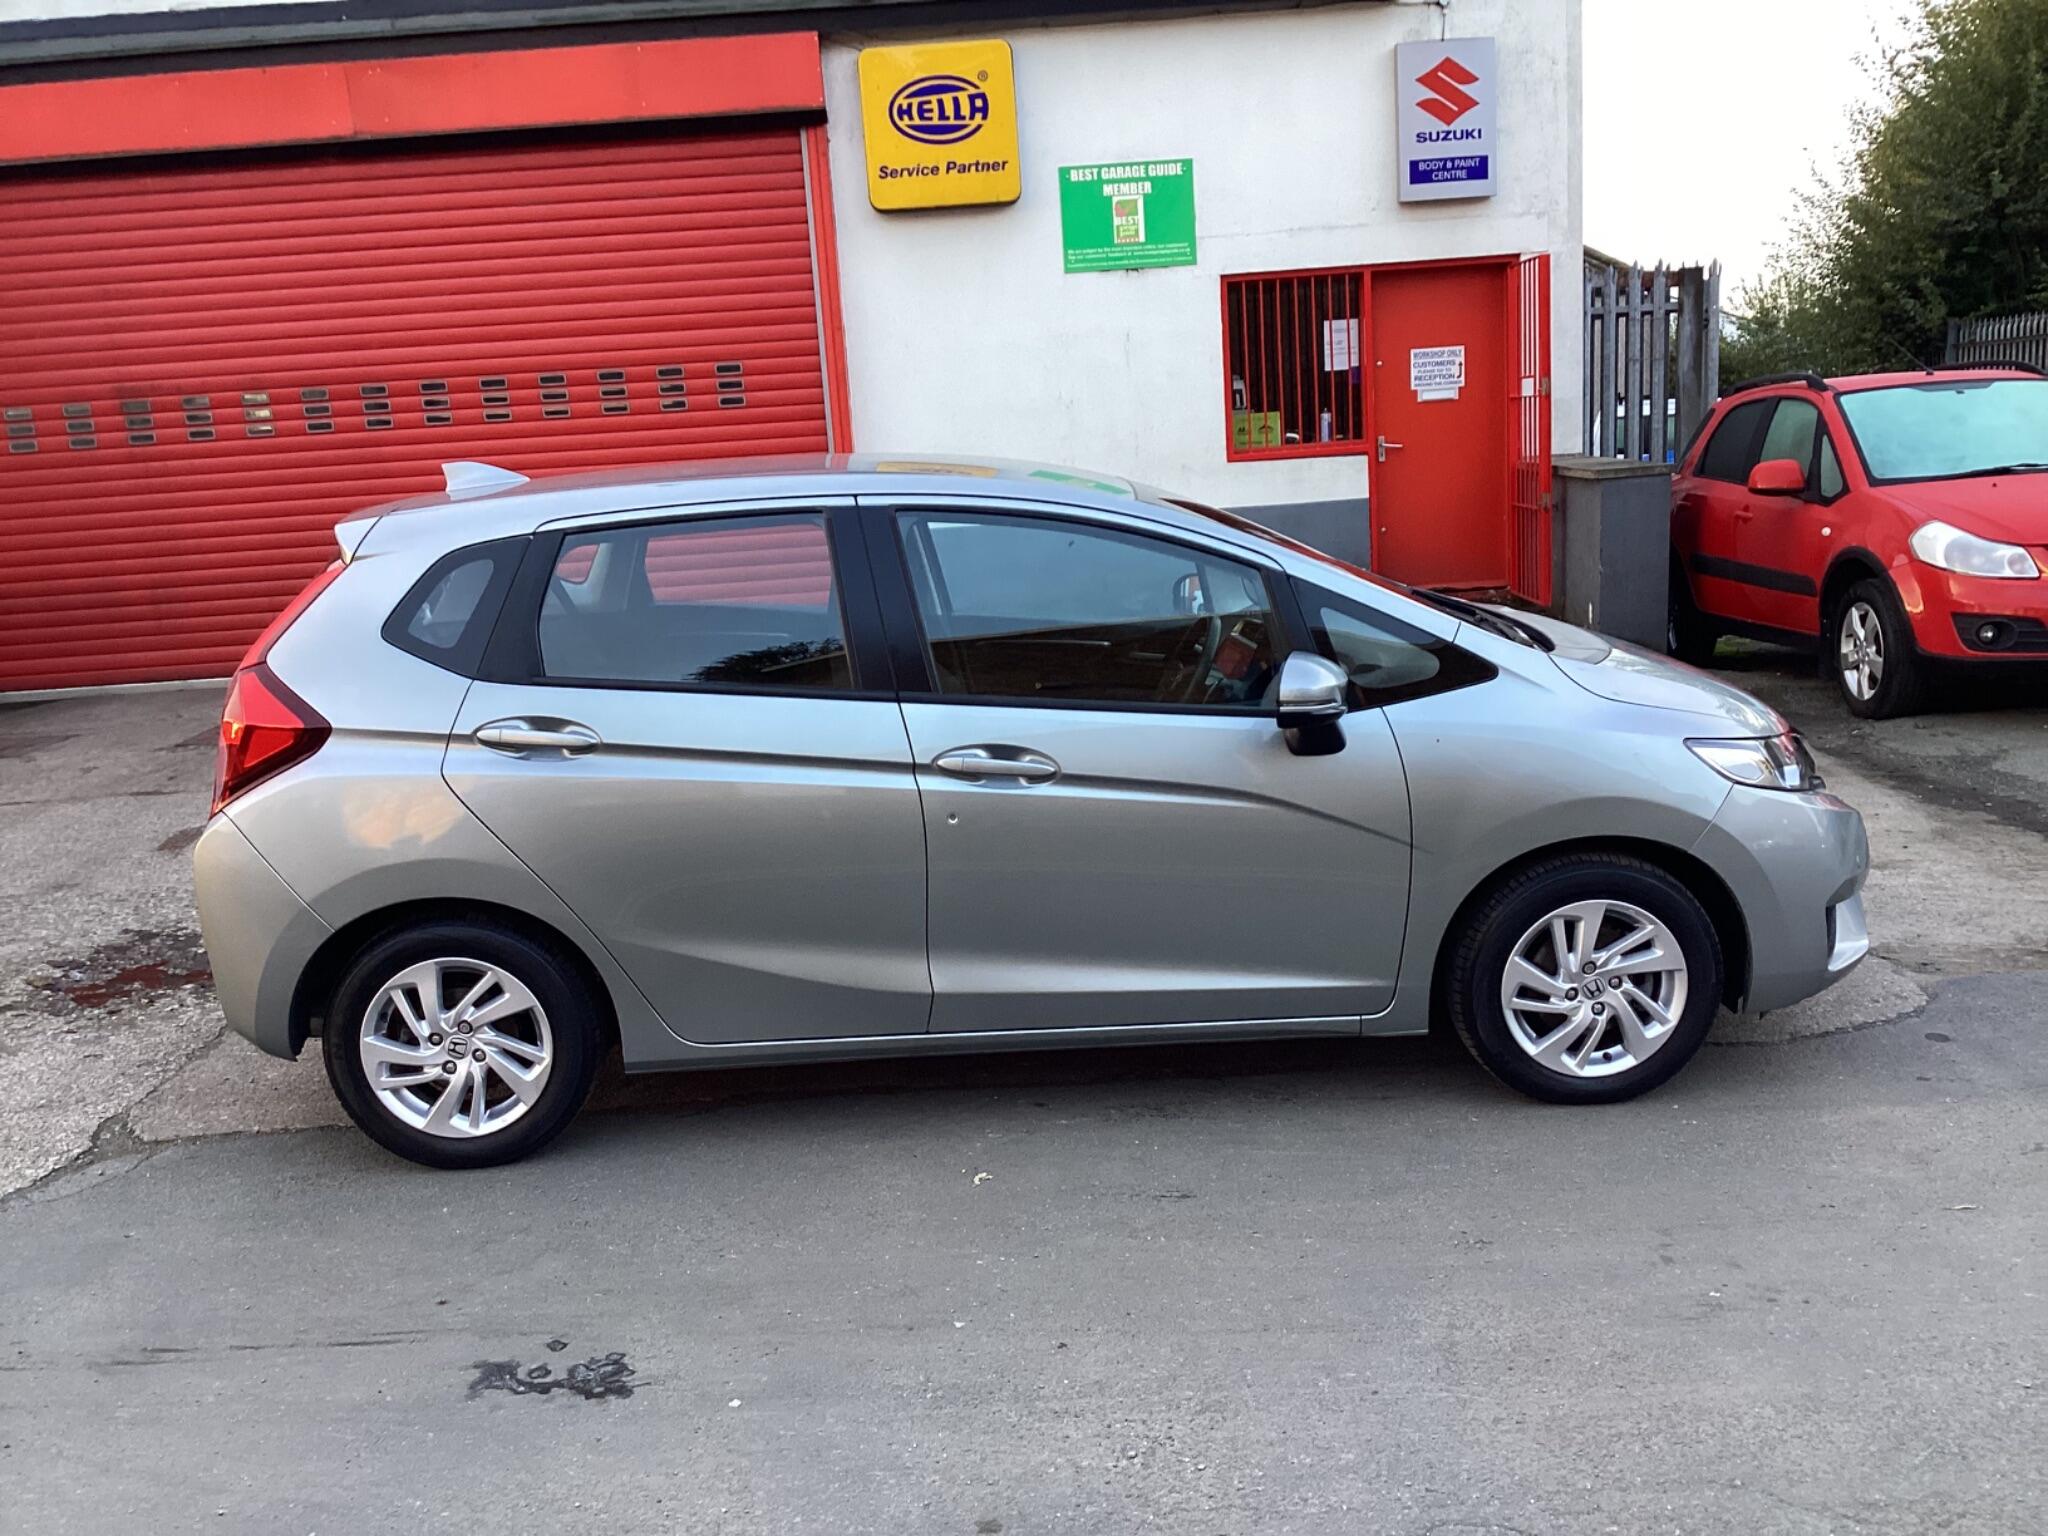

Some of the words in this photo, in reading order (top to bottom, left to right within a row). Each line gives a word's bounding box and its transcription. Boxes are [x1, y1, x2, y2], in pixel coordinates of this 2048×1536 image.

[897, 92, 989, 121] HELLA
[1416, 128, 1482, 143] SUZUKI
[878, 164, 940, 179] Service
[946, 160, 1008, 174] Partner
[1418, 161, 1445, 171] BODY
[1454, 158, 1480, 168] PAINT
[1070, 168, 1098, 182] BEST
[1101, 165, 1146, 180] GARAGE
[1148, 163, 1183, 177] GUIDE
[1432, 169, 1467, 181] CENTRE
[1103, 181, 1152, 196] MEMBER
[1413, 360, 1456, 368] CUSTOMERS
[1414, 373, 1455, 381] RECEPTION
